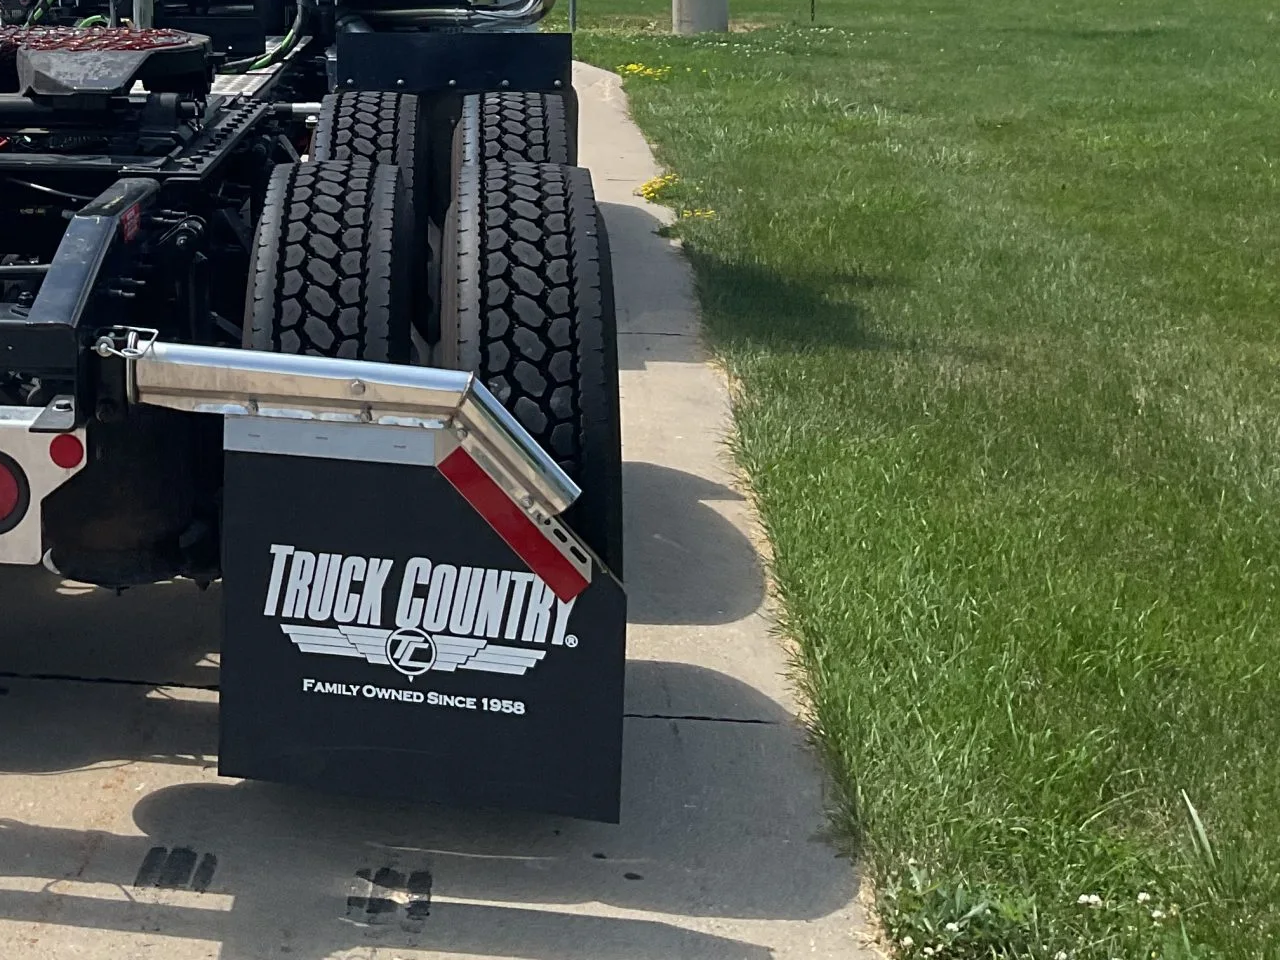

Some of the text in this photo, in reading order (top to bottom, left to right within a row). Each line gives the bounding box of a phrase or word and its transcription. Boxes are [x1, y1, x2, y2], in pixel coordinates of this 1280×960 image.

[263, 543, 578, 646] TRUCK COUNTRY
[302, 678, 526, 715] FAMILY OWNED SINCE 1958
